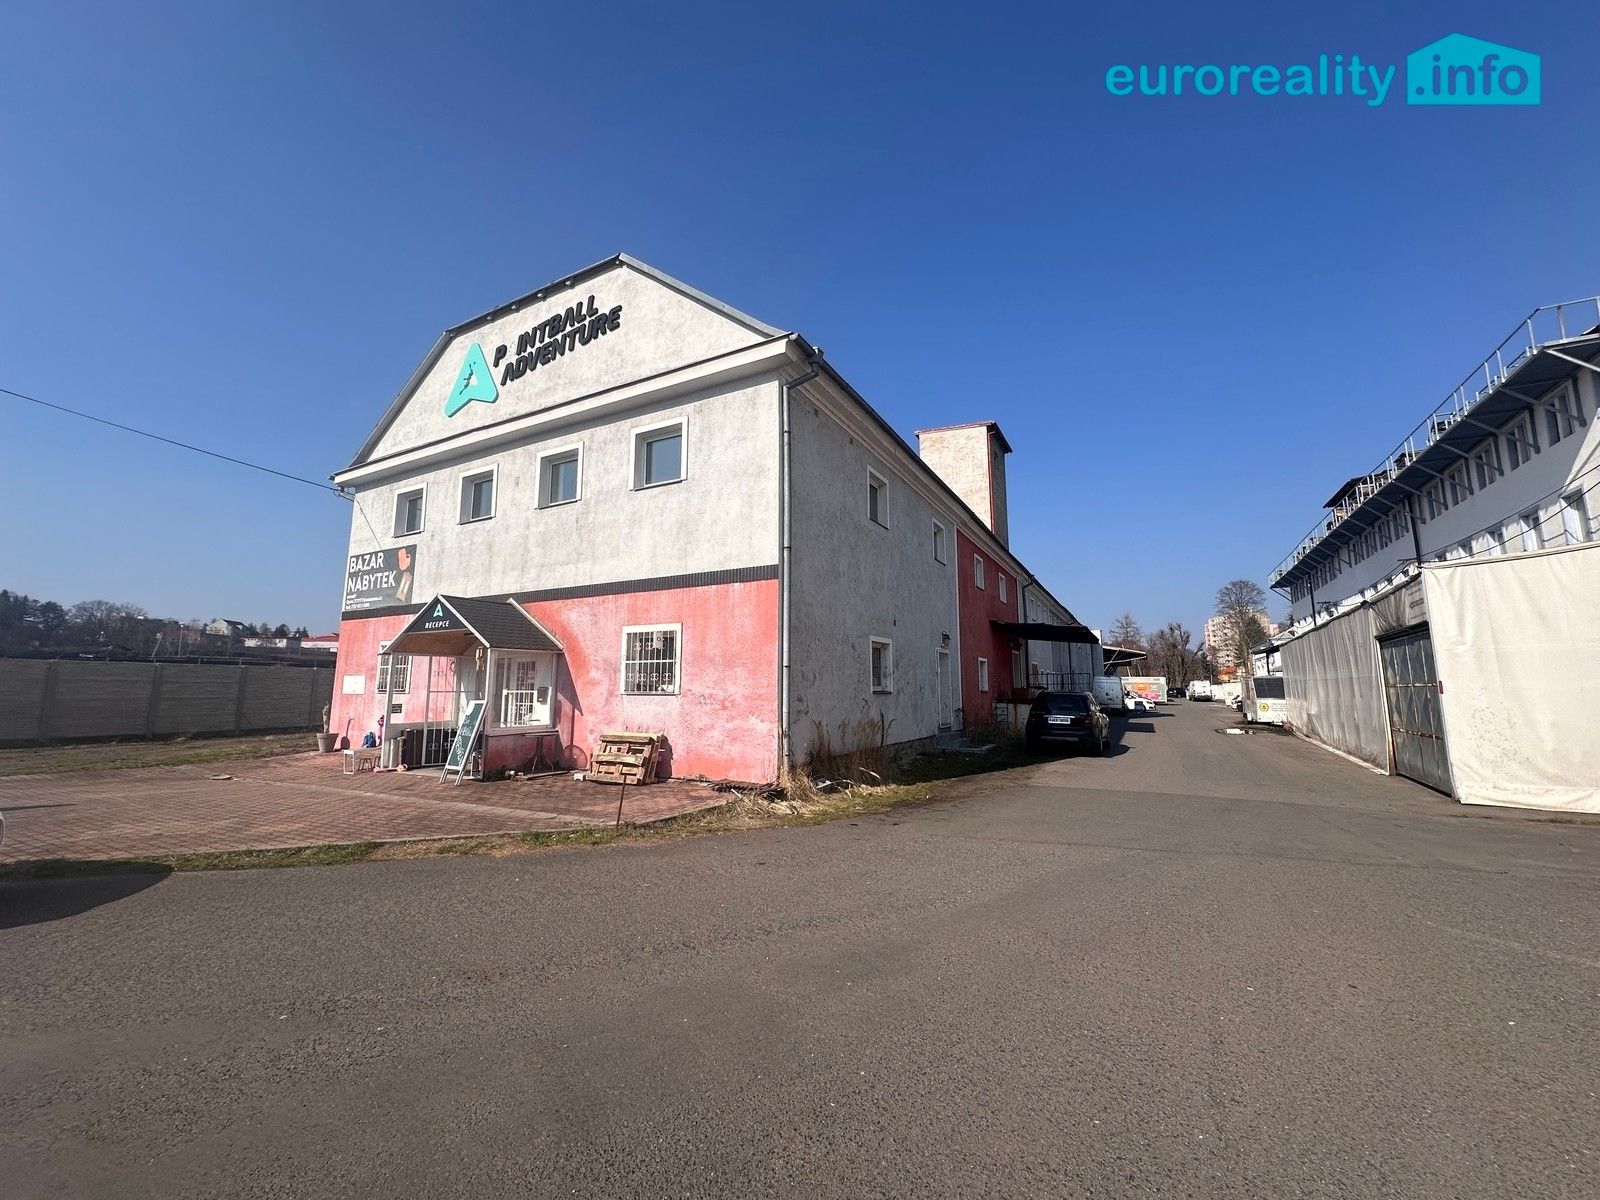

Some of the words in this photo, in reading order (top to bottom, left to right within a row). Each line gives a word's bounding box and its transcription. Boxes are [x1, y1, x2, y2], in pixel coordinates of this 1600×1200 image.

[500, 305, 622, 386] ADVENTURE
[350, 552, 384, 572] BAZAR
[348, 571, 396, 592] NÁBYTEK
[425, 620, 450, 629] RECEPCE
